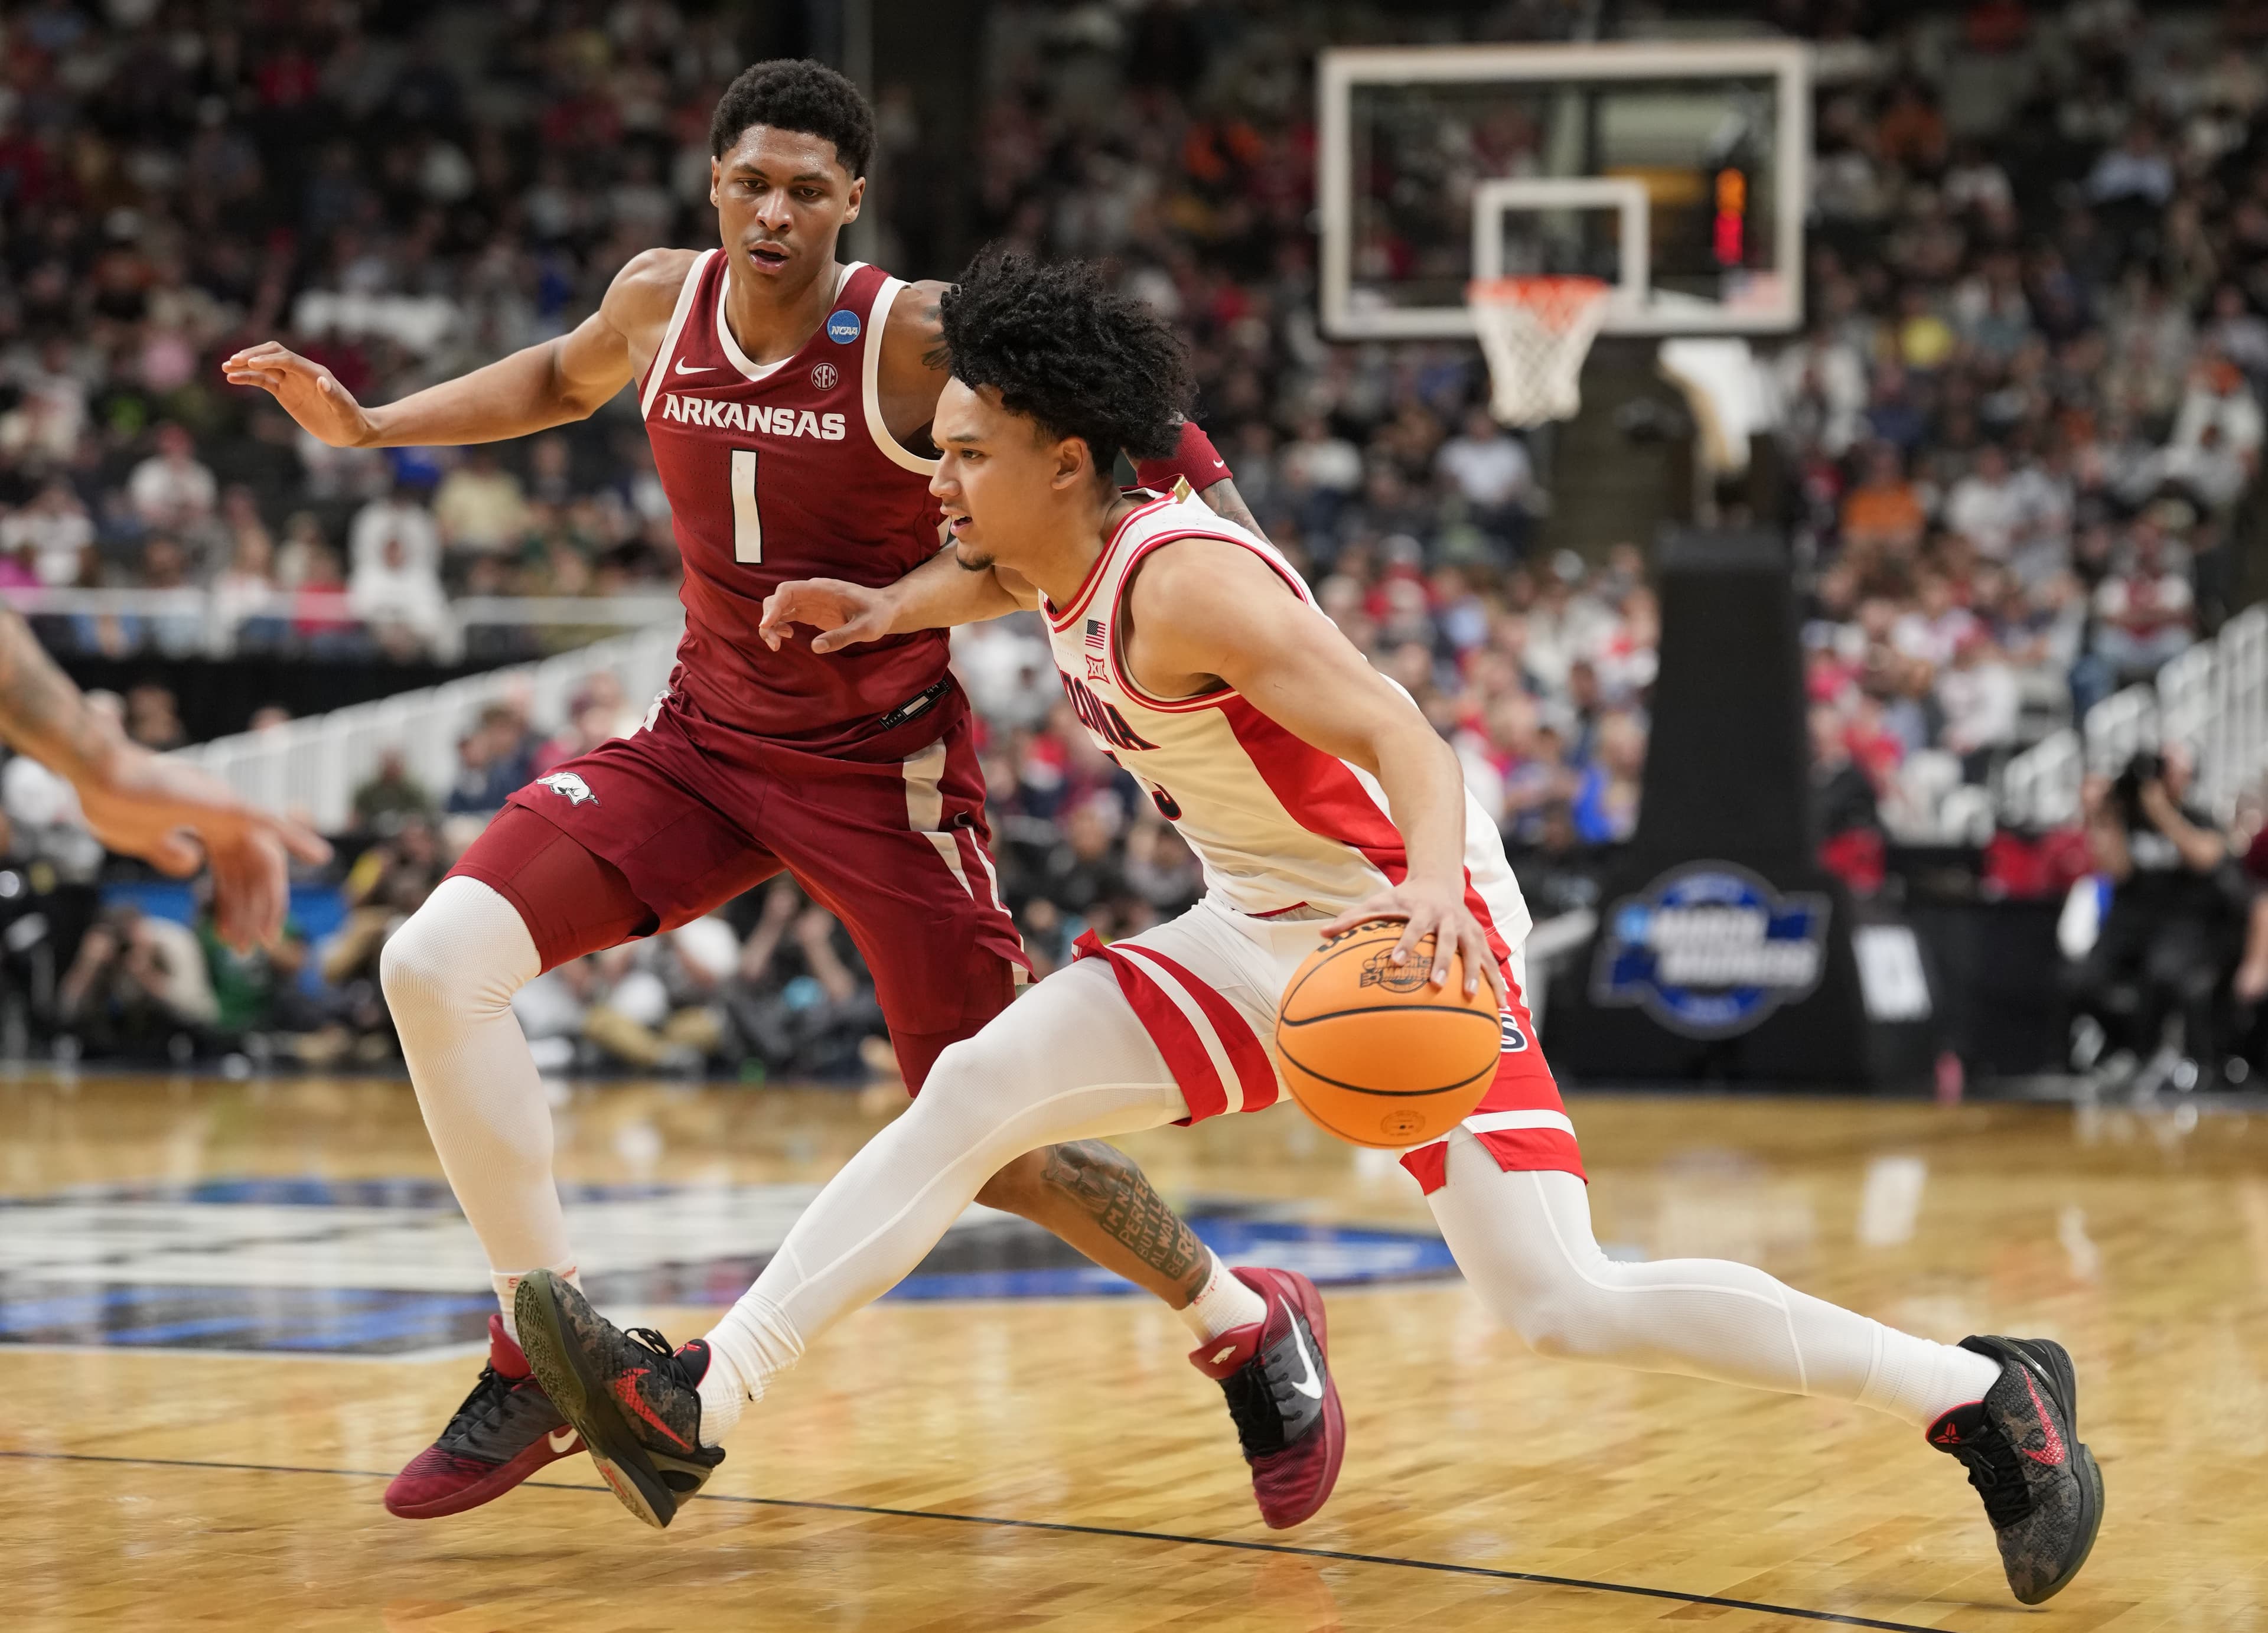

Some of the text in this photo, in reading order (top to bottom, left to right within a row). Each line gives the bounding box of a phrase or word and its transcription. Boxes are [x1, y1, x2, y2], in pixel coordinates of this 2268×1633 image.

[832, 326, 858, 335] NCAA
[814, 365, 835, 388] SEC
[662, 393, 846, 441] ARKANSAS
[731, 448, 763, 565] 1
[1059, 669, 1162, 751] ZONA
[1116, 1169, 1133, 1208] NOT
[1118, 1170, 1149, 1247] PERFEC
[1136, 1225, 1156, 1257] BUT
[1166, 1221, 1195, 1276] BE RE
